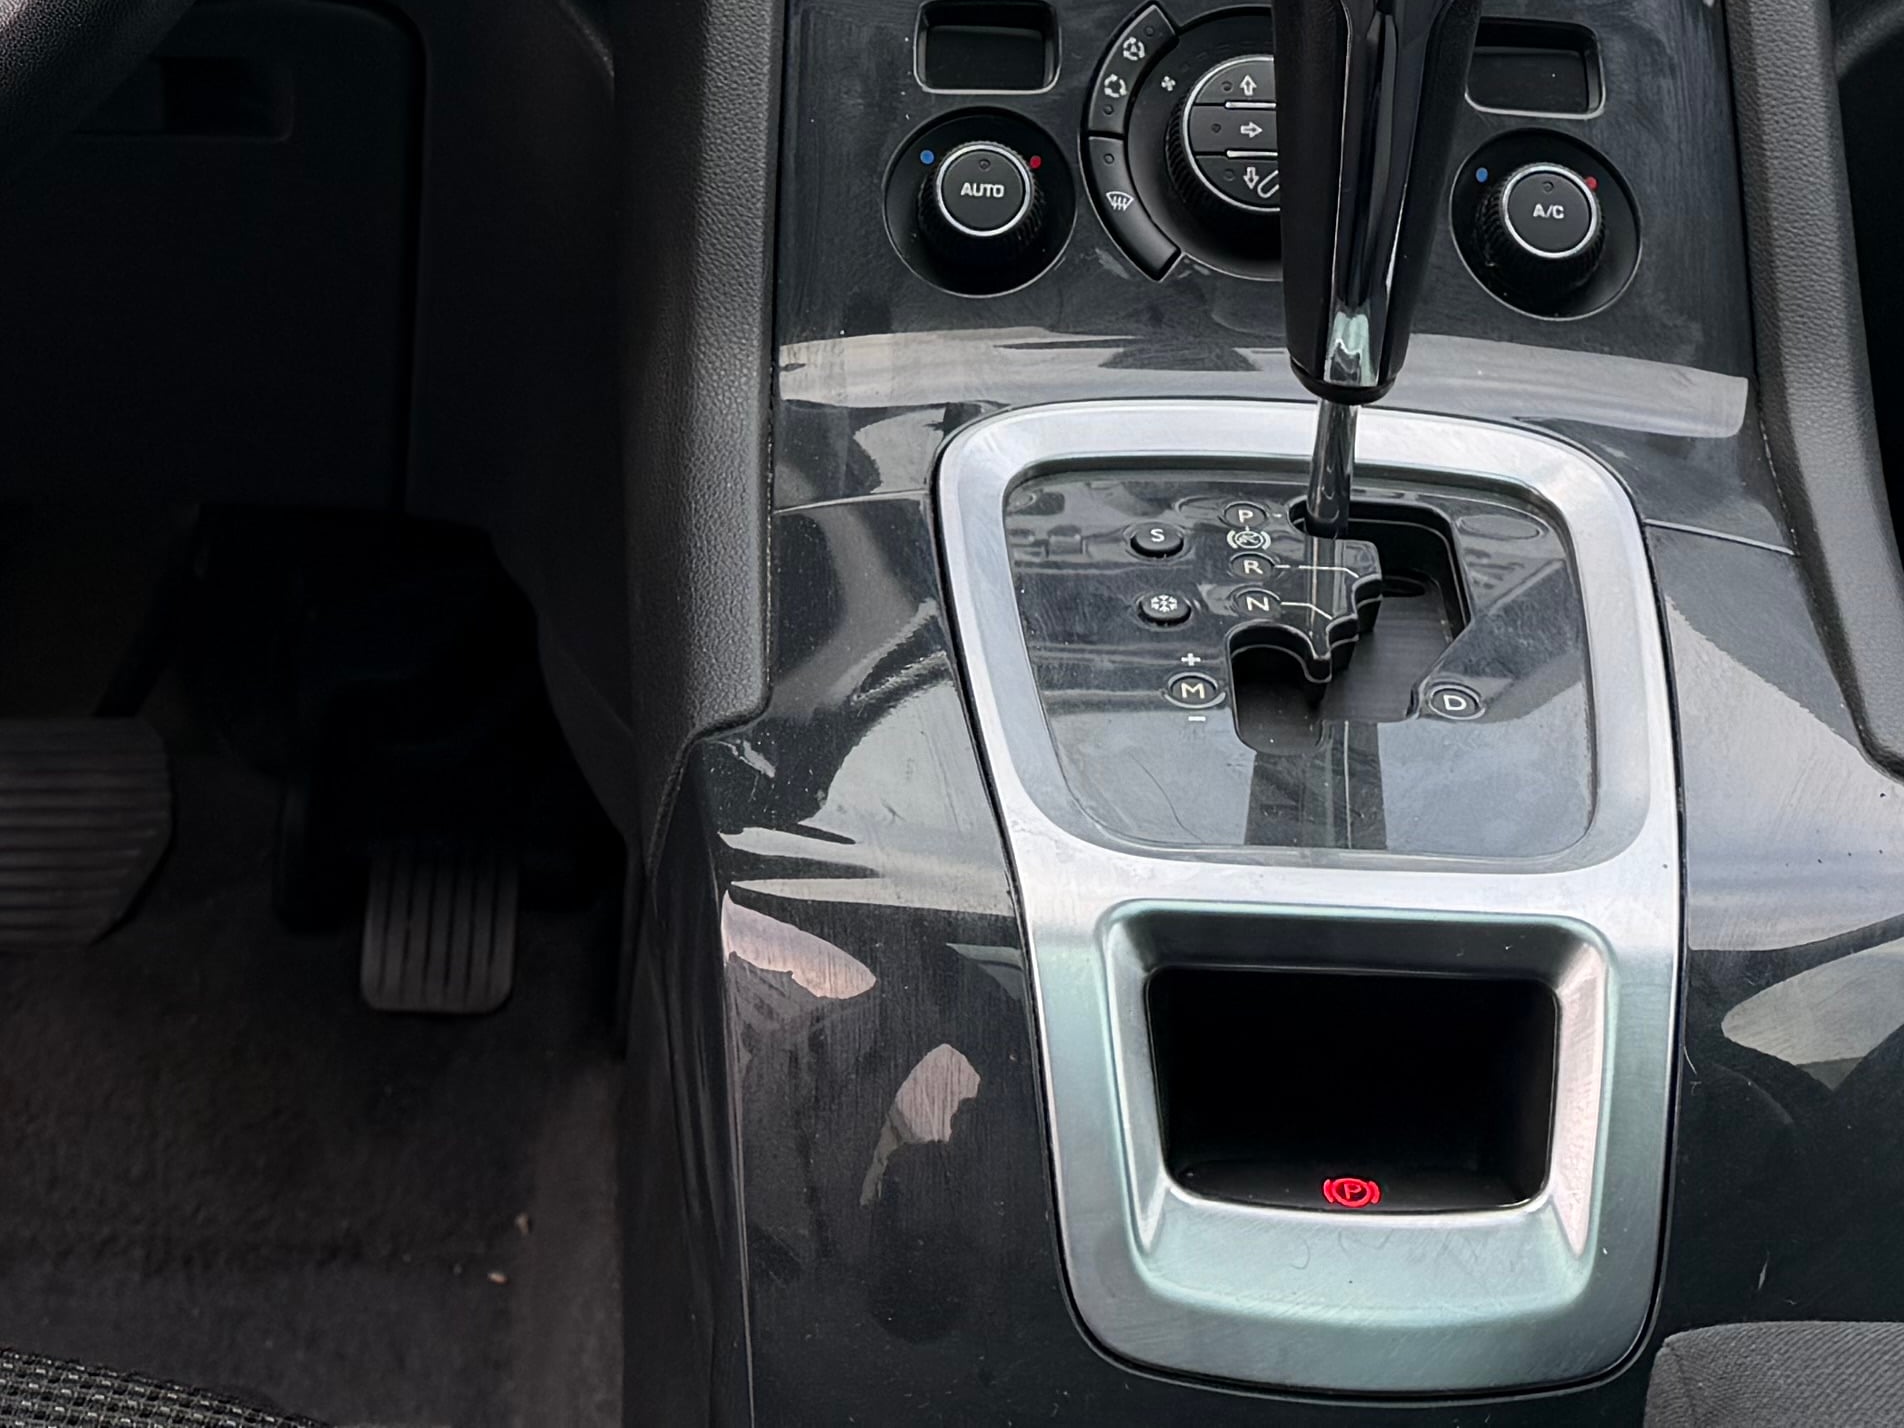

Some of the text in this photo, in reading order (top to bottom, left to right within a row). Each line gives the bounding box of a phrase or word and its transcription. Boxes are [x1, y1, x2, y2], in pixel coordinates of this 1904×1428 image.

[960, 182, 1005, 198] AUTO
[1532, 203, 1565, 219] A/C
[1238, 509, 1254, 524] P
[1149, 526, 1165, 543] S
[1243, 559, 1264, 575] R
[1246, 596, 1270, 612] N
[1181, 682, 1206, 700] M
[1443, 694, 1466, 712] D
